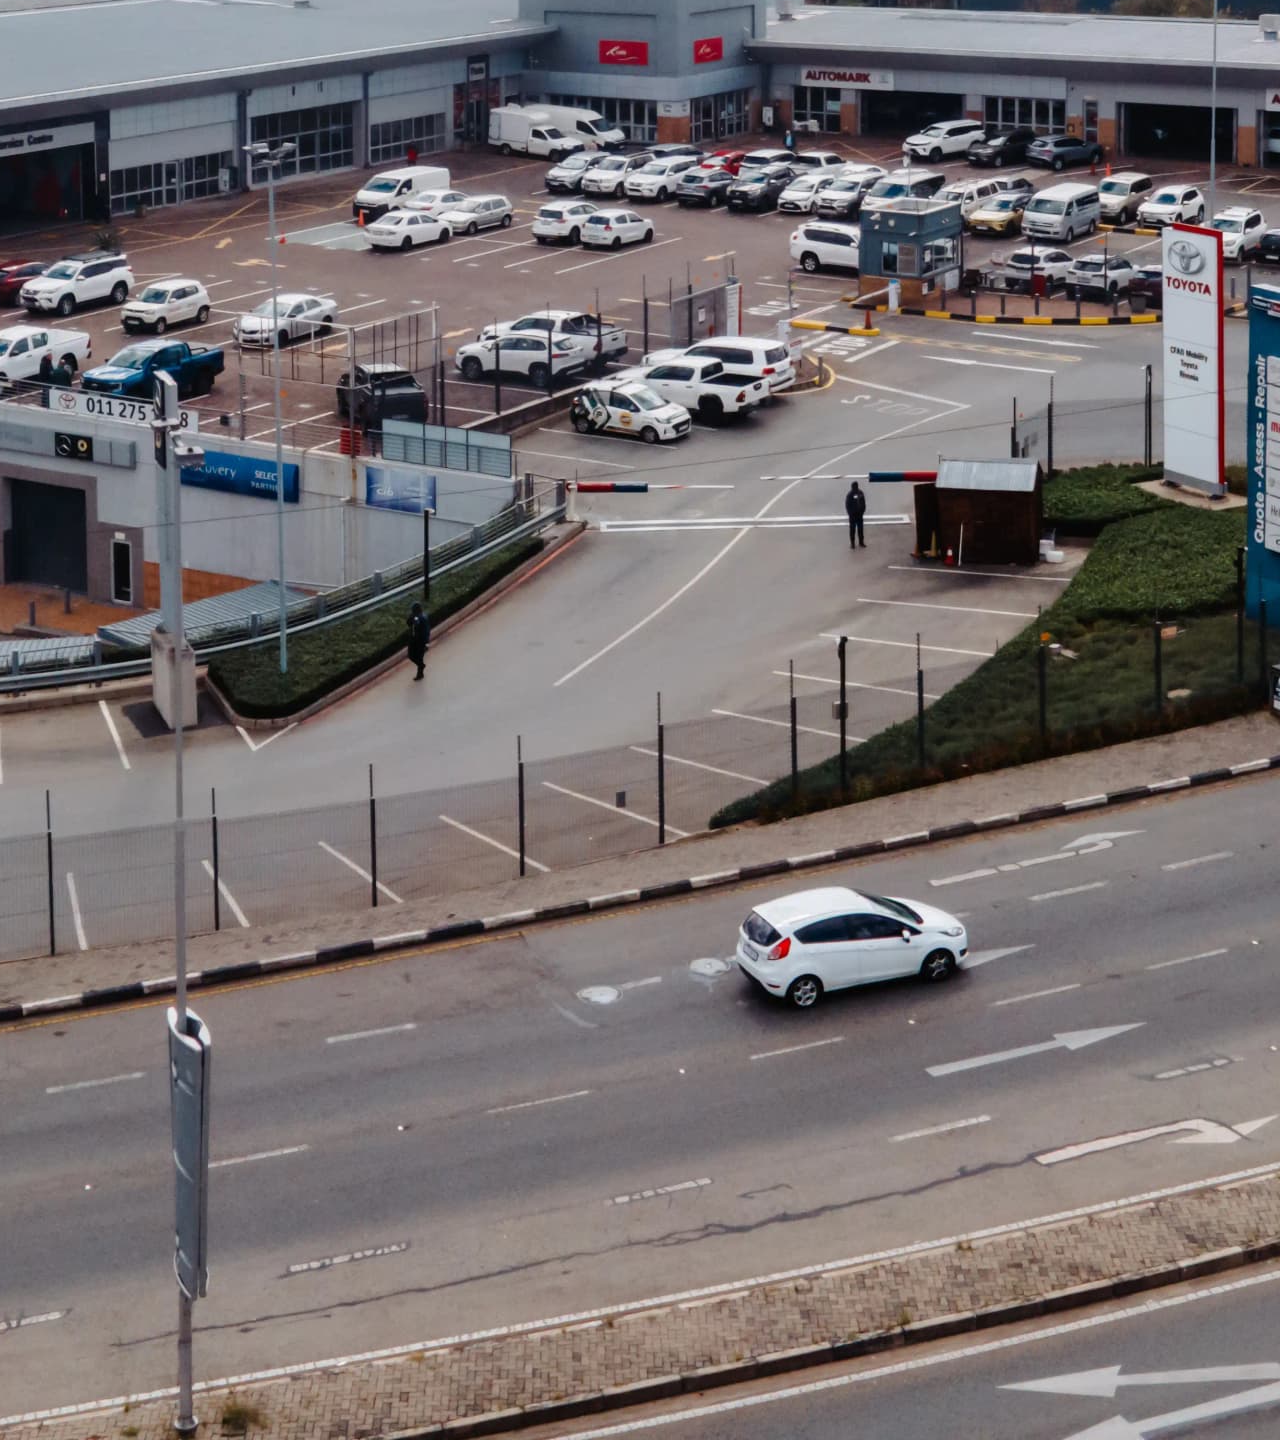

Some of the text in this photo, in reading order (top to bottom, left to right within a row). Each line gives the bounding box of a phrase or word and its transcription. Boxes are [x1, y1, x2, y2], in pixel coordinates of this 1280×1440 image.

[805, 70, 872, 84] AUTOMARK
[27, 133, 54, 146] Centre
[1166, 276, 1212, 297] TOYOTA
[1180, 360, 1199, 371] Toyota
[1186, 348, 1208, 363] Mobility
[1254, 354, 1267, 408] Repair
[86, 397, 115, 417] 011
[119, 402, 147, 422] 275
[1253, 424, 1265, 476] Assess
[1254, 494, 1265, 544] Quote
